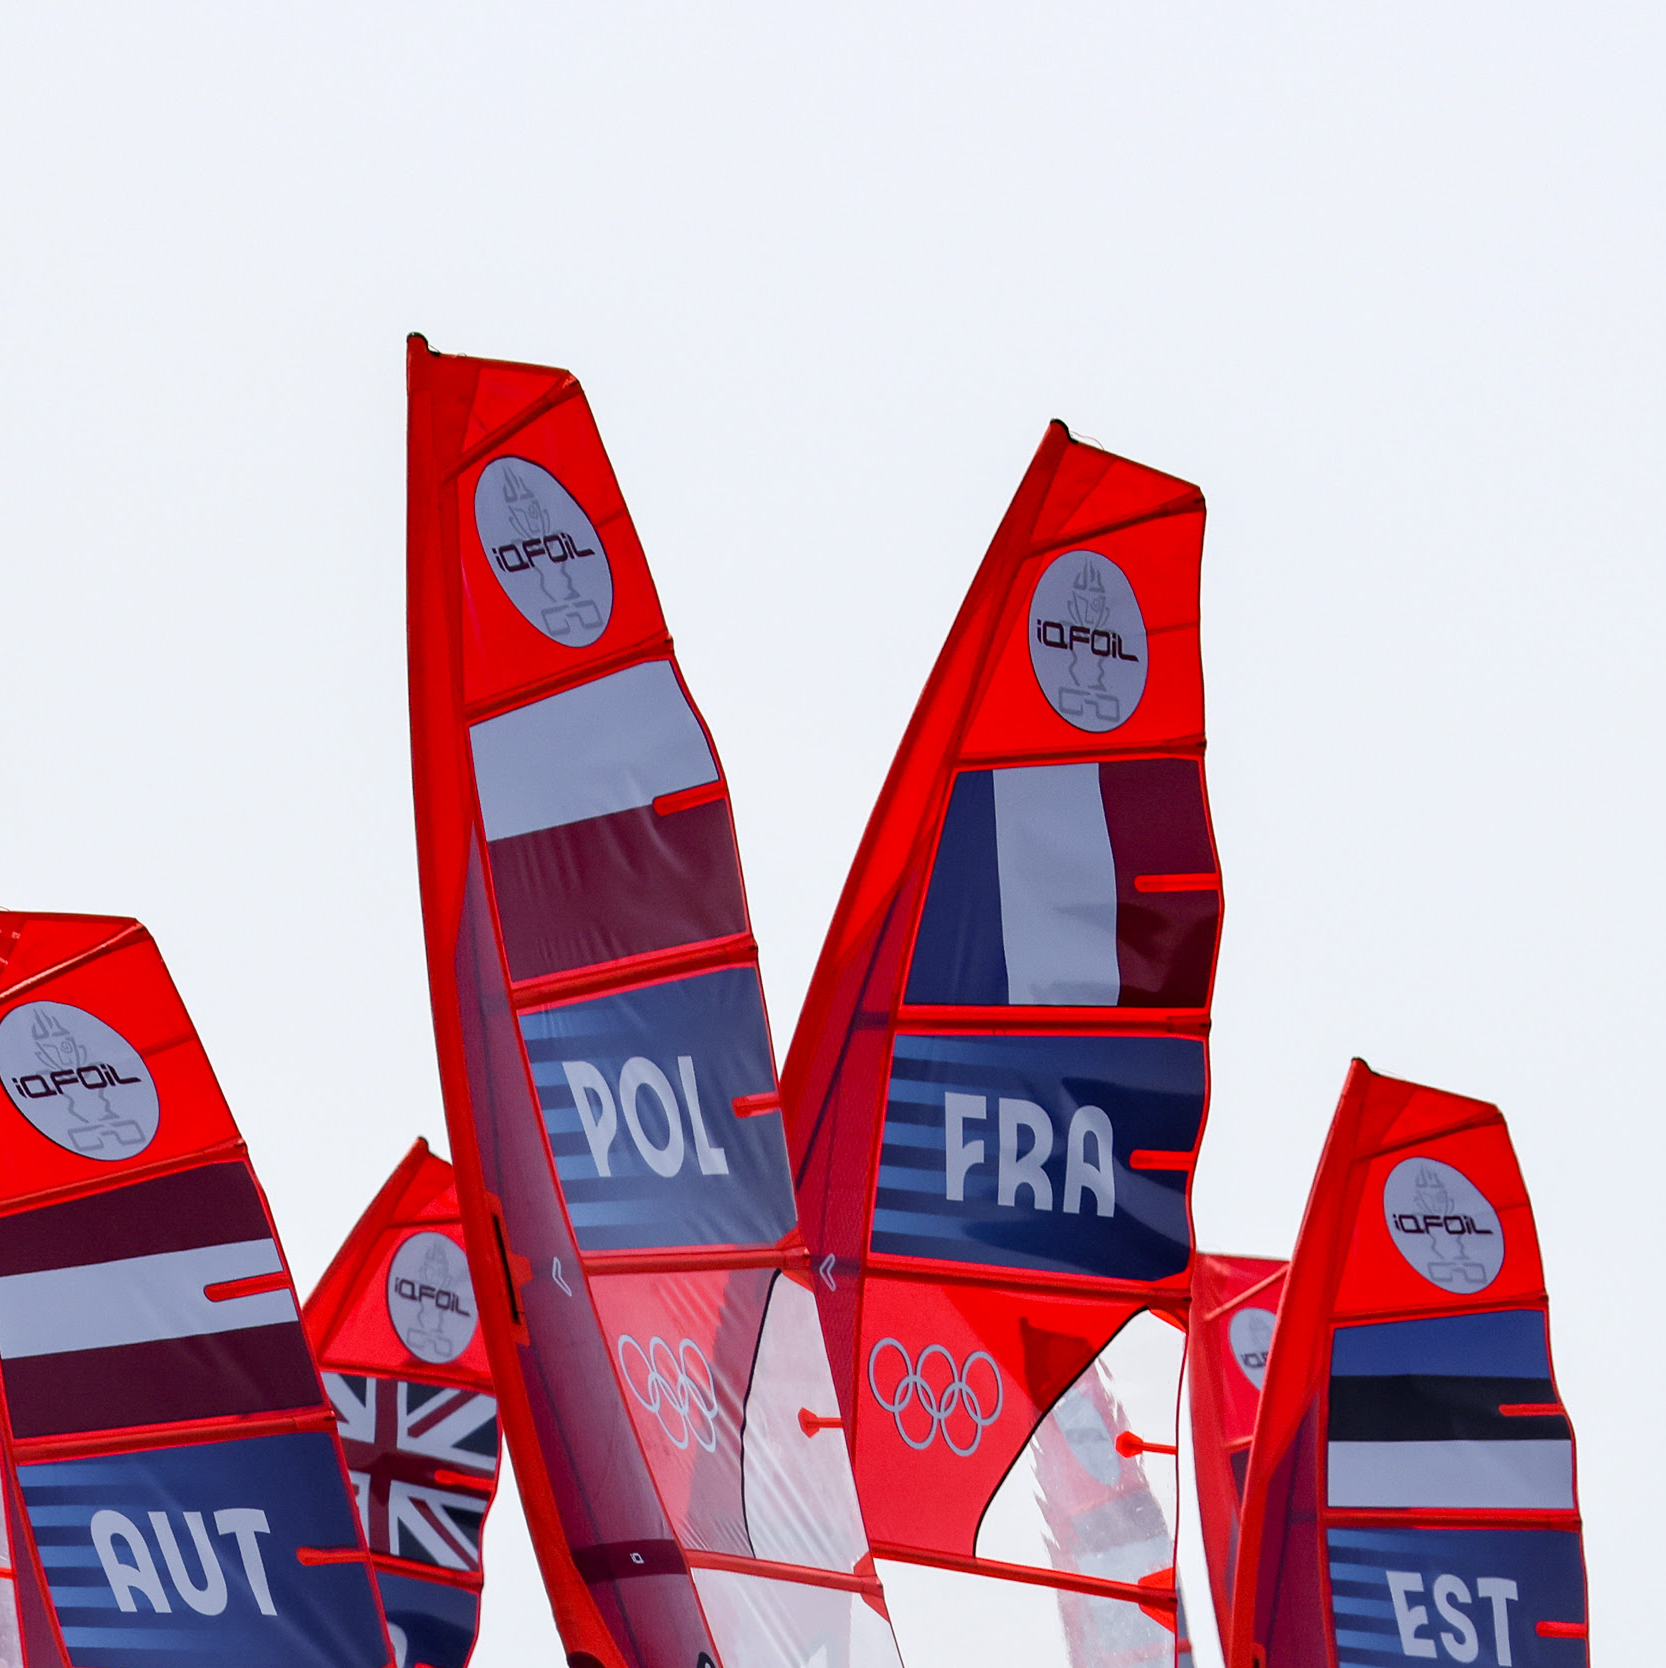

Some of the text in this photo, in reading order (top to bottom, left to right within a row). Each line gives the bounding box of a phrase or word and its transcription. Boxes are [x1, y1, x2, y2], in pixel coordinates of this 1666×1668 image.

[563, 1054, 730, 1178] POL
[944, 1091, 1115, 1217] FRA
[90, 1507, 279, 1618] AUT
[1385, 1570, 1519, 1668] EST
